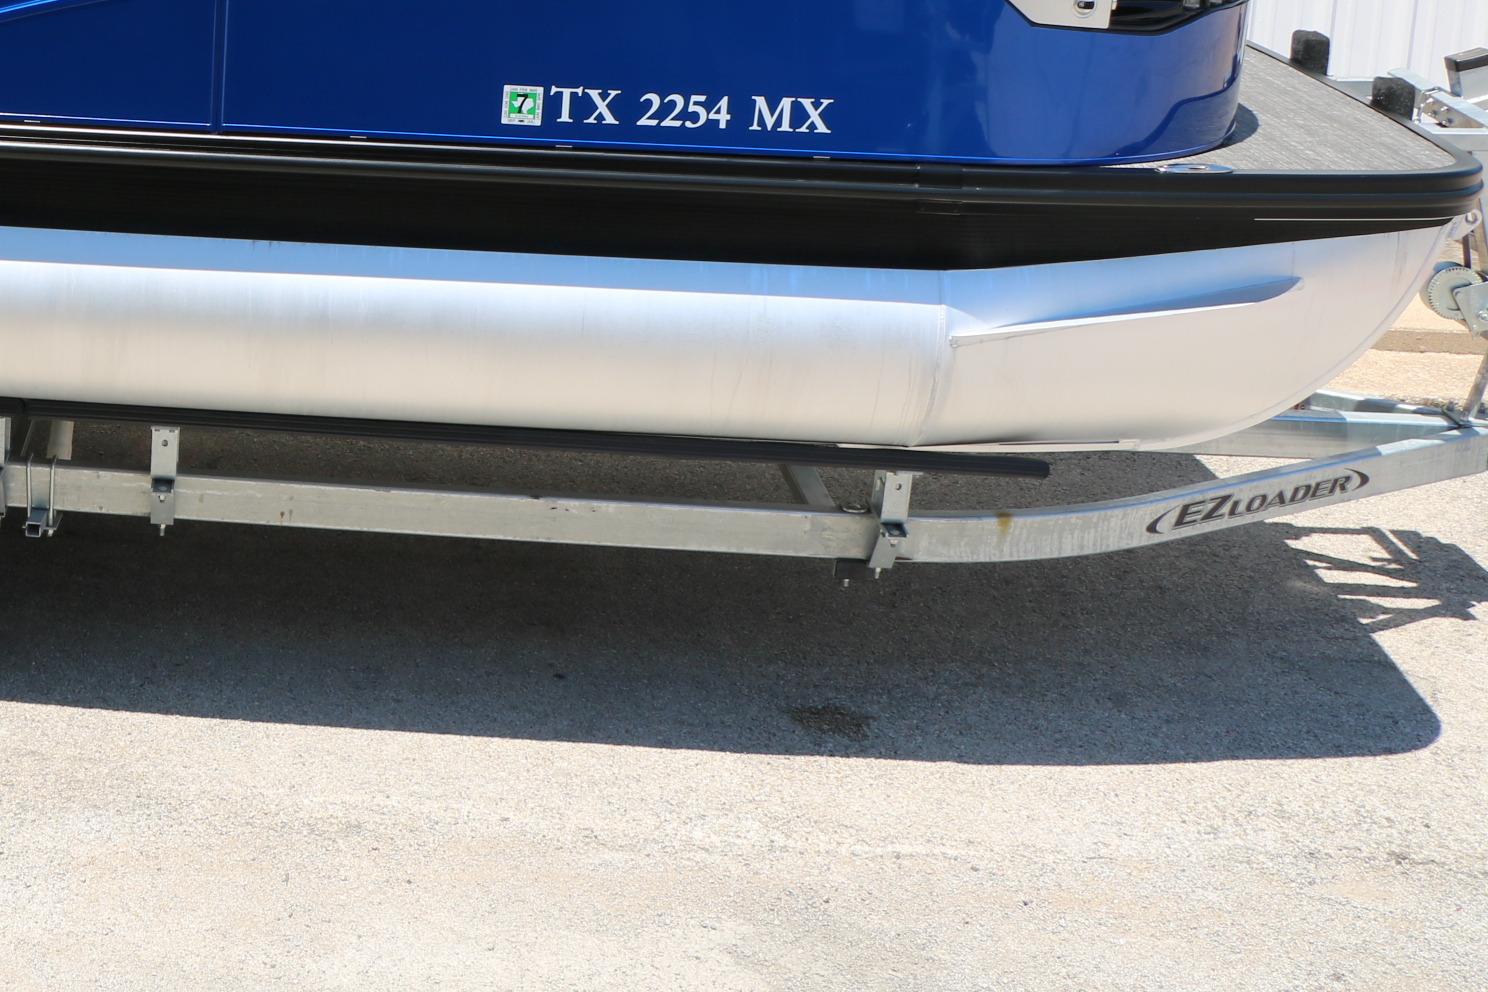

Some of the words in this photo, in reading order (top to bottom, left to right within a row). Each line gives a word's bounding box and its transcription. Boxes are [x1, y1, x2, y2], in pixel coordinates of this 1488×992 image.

[516, 93, 529, 114] 7
[550, 85, 622, 125] TX
[636, 92, 731, 129] 2254
[748, 95, 835, 134] MX
